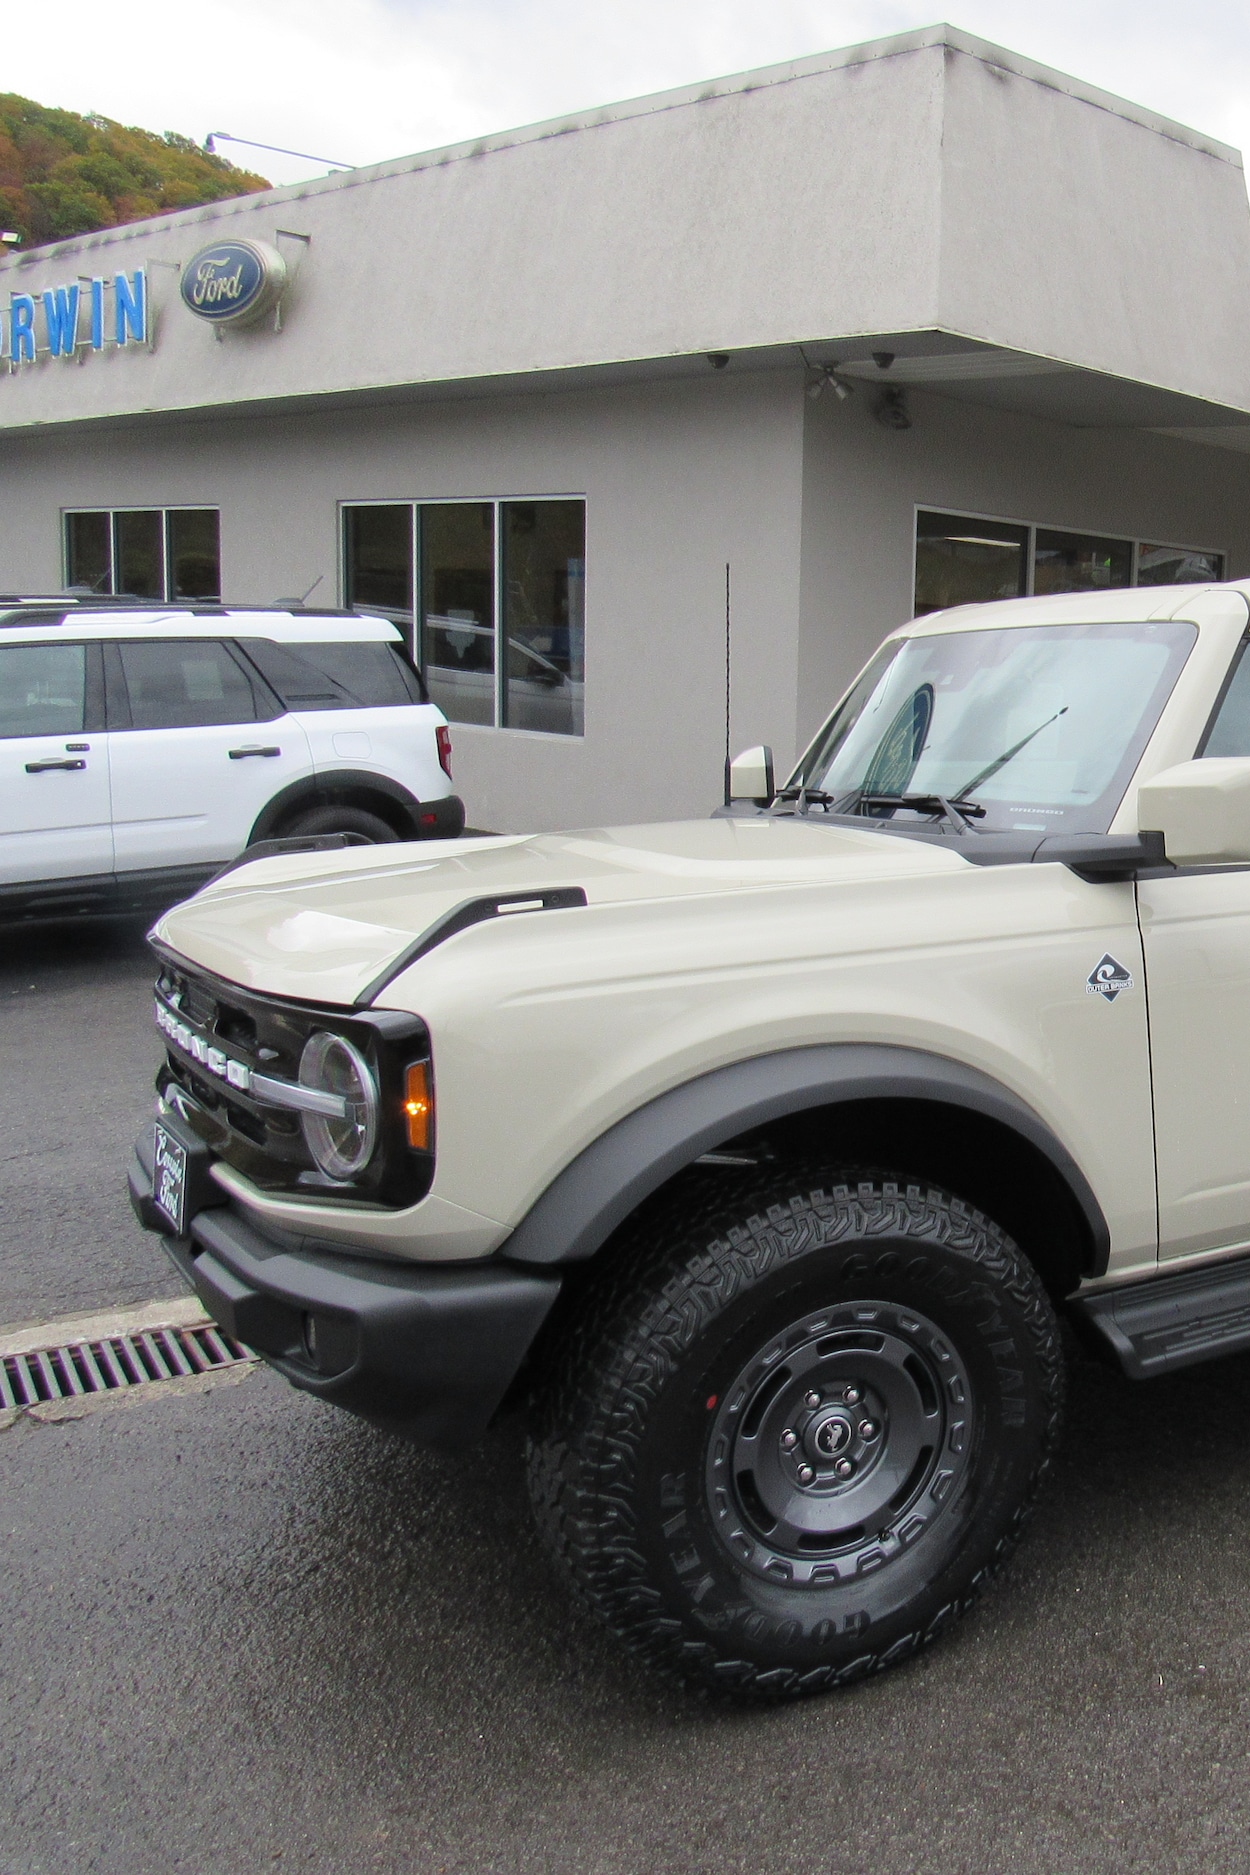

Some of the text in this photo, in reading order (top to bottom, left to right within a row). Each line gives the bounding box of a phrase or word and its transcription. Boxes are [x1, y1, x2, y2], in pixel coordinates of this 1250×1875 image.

[193, 256, 243, 305] Ford
[0, 267, 146, 364] RWIN
[1087, 983, 1110, 993] OUTER
[156, 1000, 249, 1090] BRONCO
